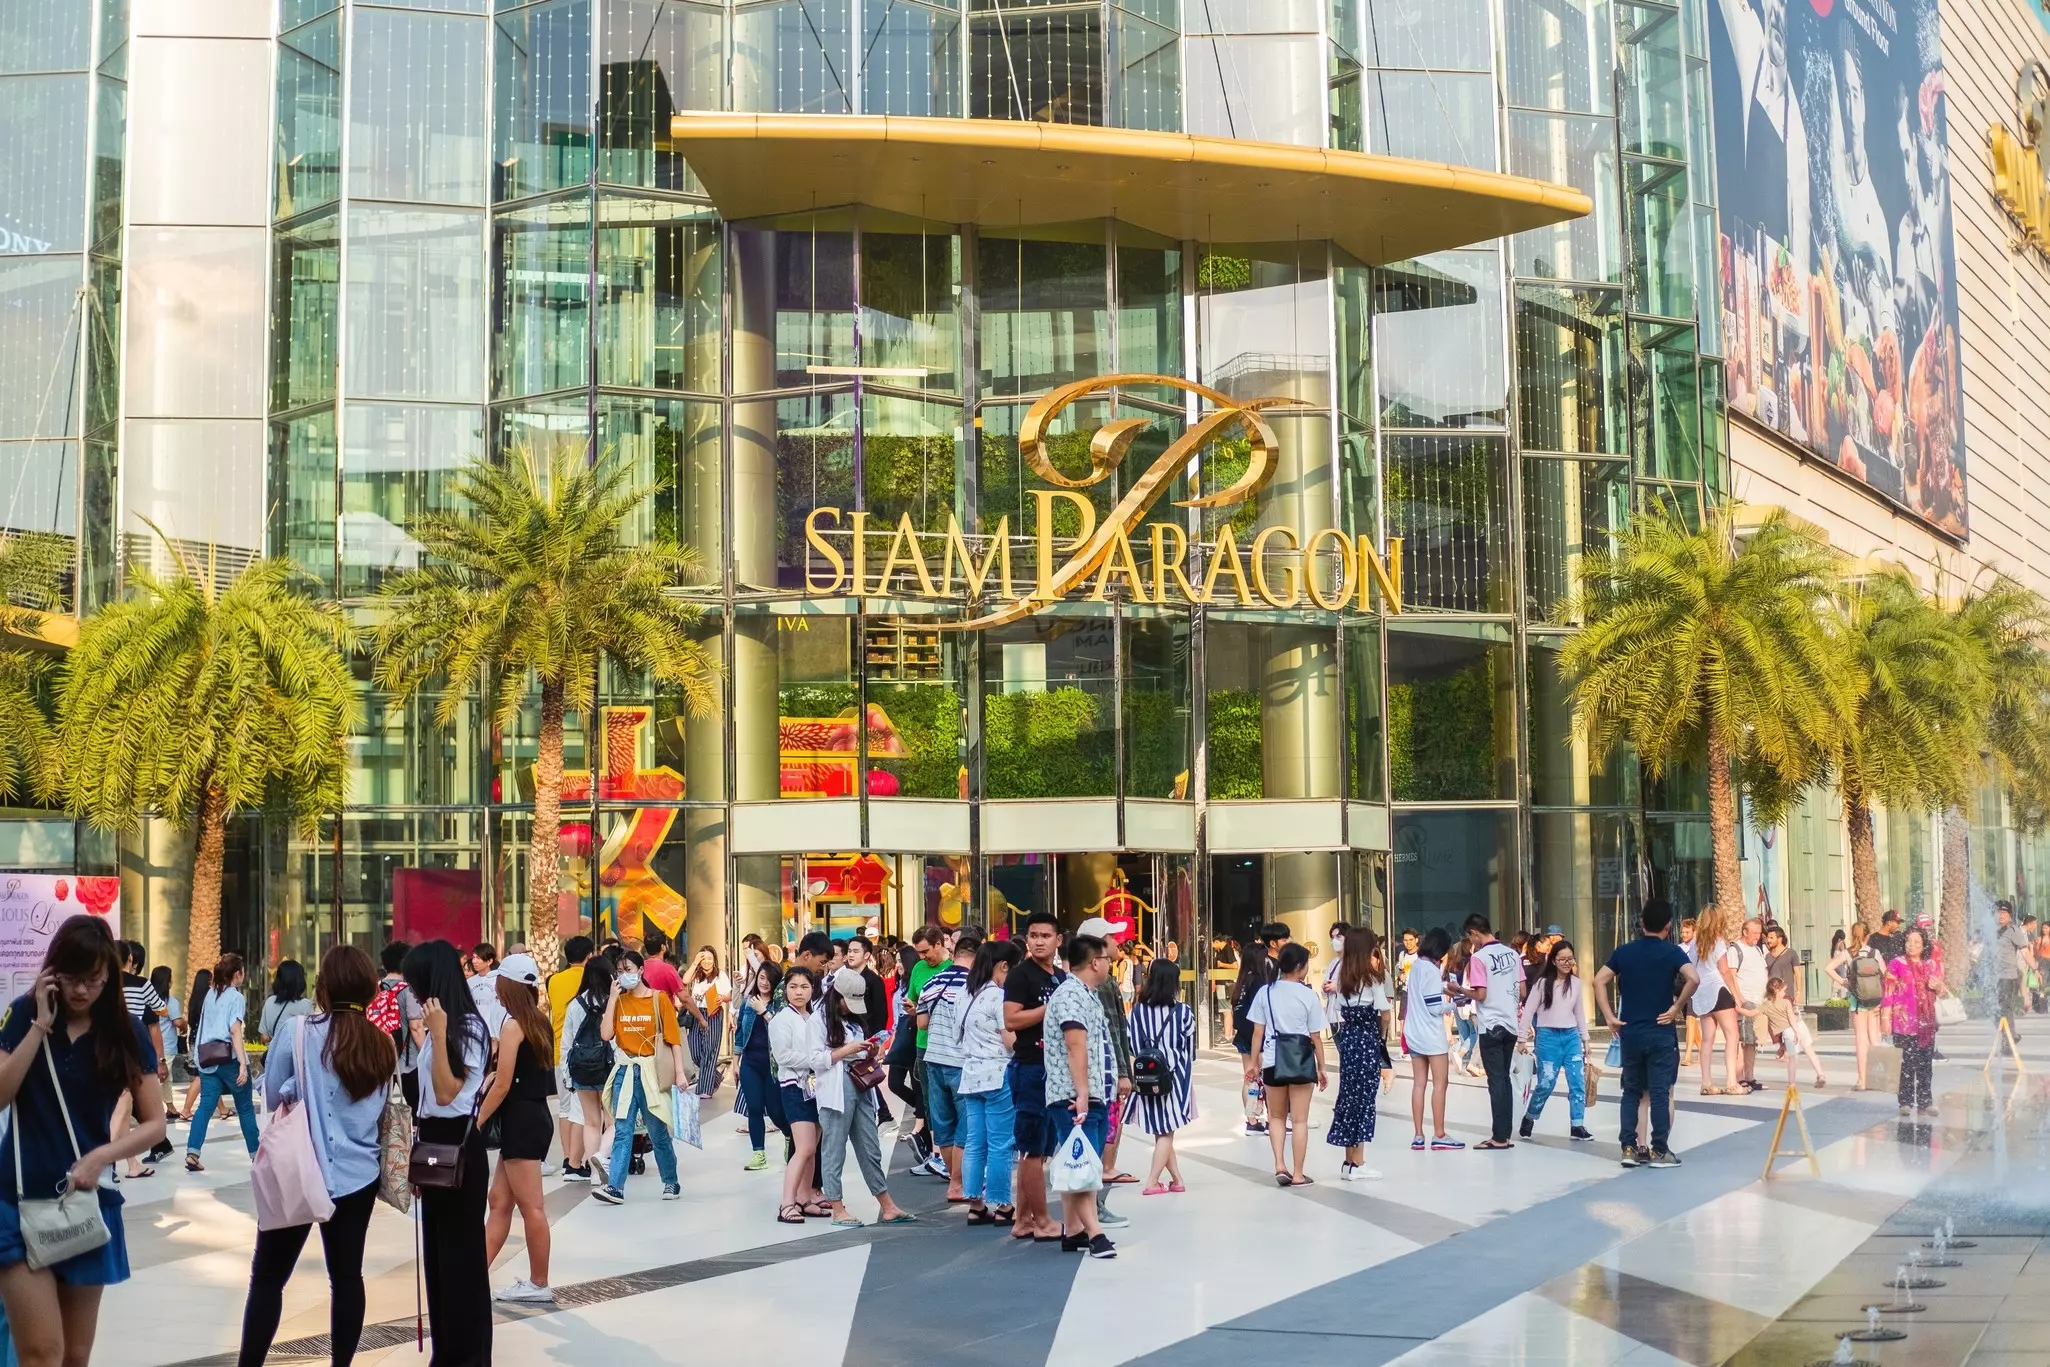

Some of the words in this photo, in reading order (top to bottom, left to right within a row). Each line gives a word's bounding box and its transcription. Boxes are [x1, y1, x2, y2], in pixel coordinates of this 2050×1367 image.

[805, 506, 1012, 600] SIAM
[1026, 489, 1406, 616] PARAGON
[0, 908, 29, 922] IOUS
